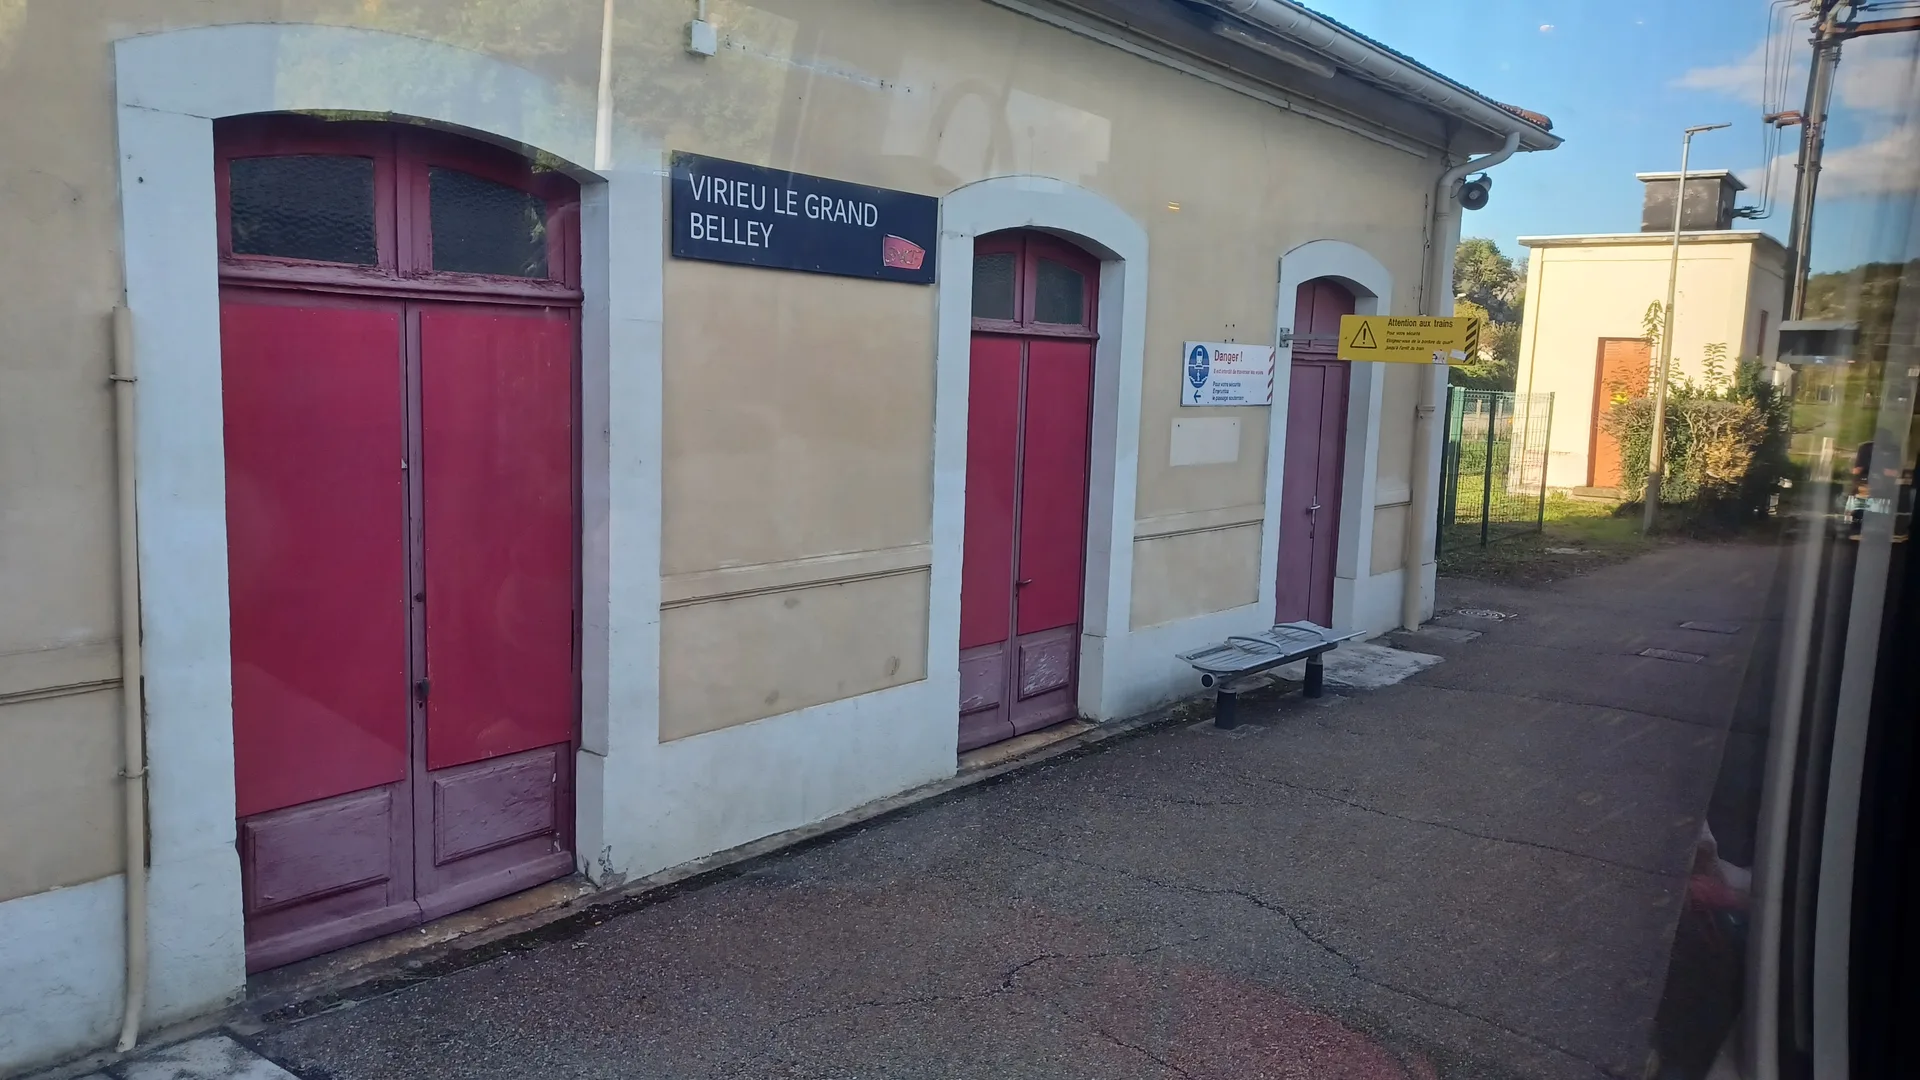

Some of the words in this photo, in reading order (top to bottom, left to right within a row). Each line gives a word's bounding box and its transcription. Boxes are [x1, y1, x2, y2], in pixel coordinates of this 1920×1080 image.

[689, 173, 766, 211] VIRIEU
[774, 188, 798, 216] LE
[805, 193, 878, 227] GRAND
[690, 212, 773, 248] BELLEY
[1388, 318, 1417, 327] Attention
[1434, 319, 1453, 328] trains
[1214, 349, 1239, 364] Danger
